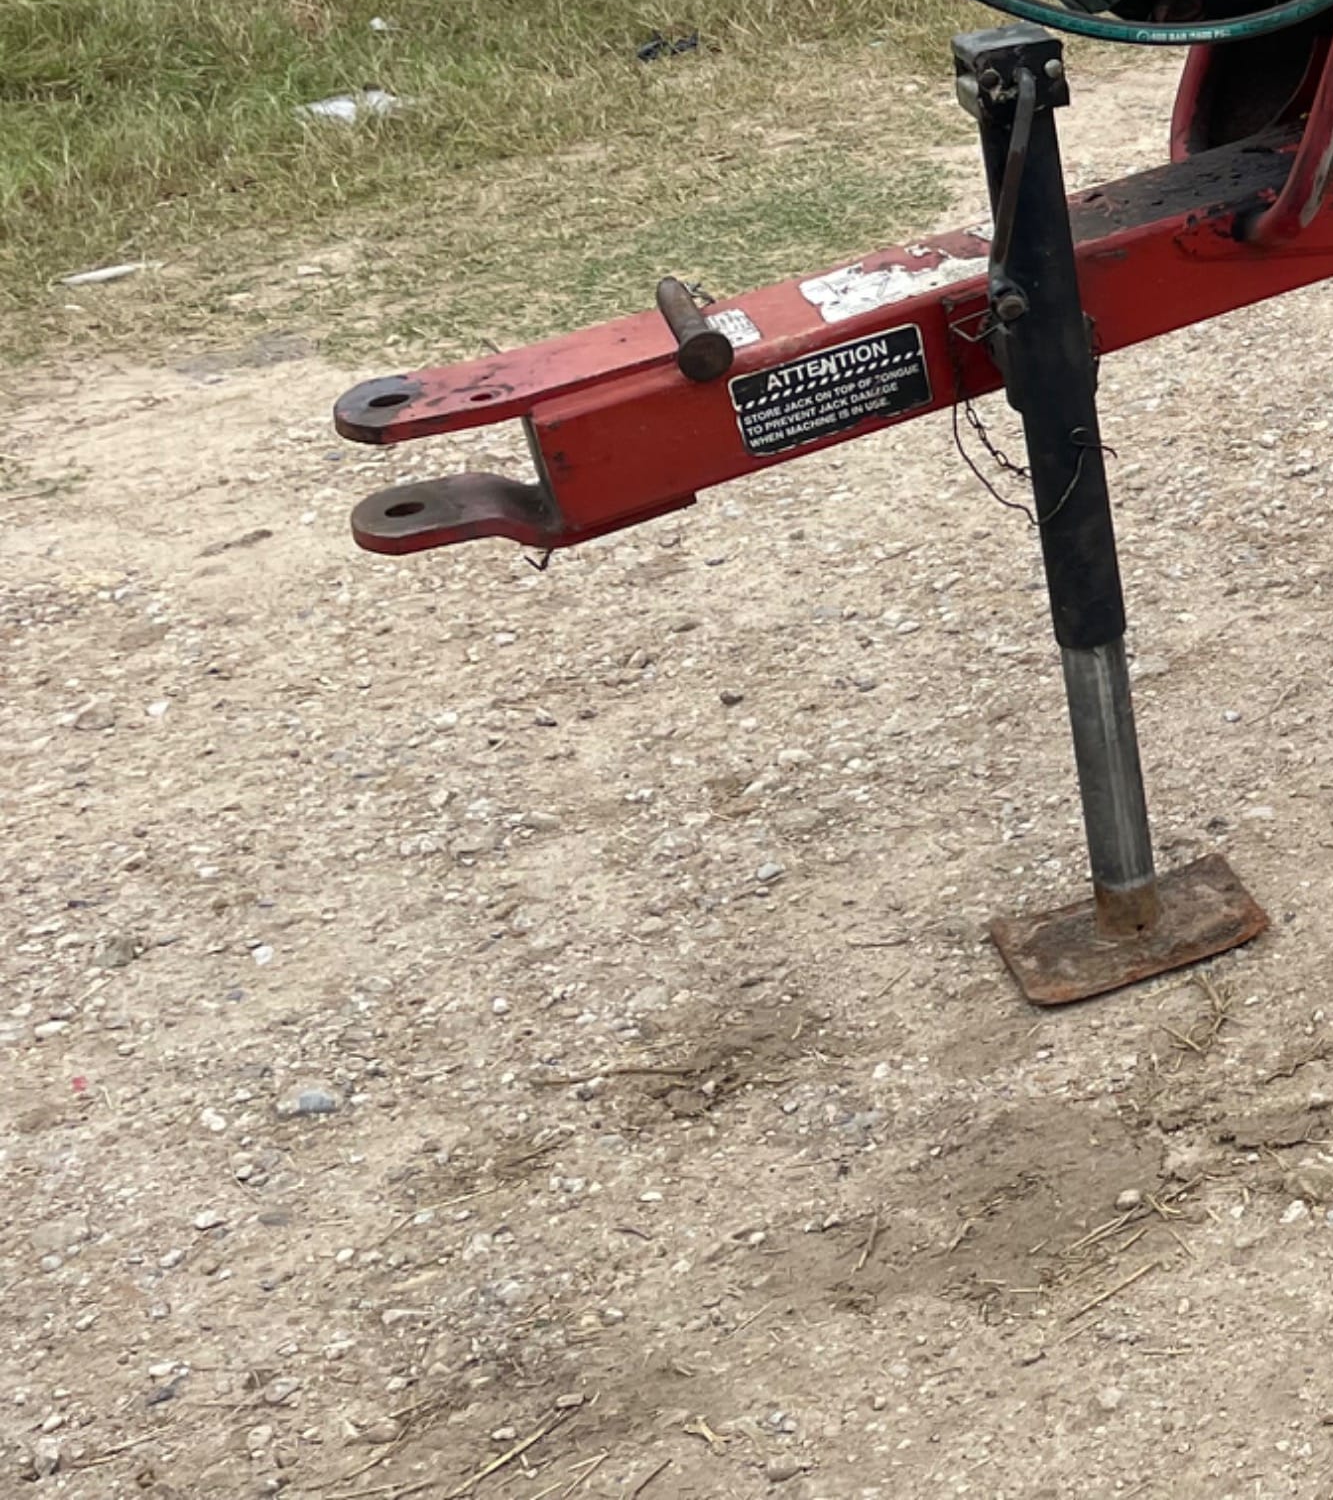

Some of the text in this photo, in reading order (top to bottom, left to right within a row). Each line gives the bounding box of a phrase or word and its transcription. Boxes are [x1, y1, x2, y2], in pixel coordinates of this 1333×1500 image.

[767, 339, 888, 391] ATTENTION
[743, 406, 781, 426] STORE
[783, 396, 814, 413] JACK
[815, 390, 832, 403] ON
[833, 382, 856, 396] TOP
[857, 377, 872, 389] OF
[746, 424, 762, 437] TO
[765, 406, 817, 431] PREVENT
[819, 398, 848, 414] JACK
[749, 431, 785, 448] WHEN
[785, 412, 838, 437] MACHINE
[838, 408, 850, 420] IS
[850, 404, 864, 415] IN
